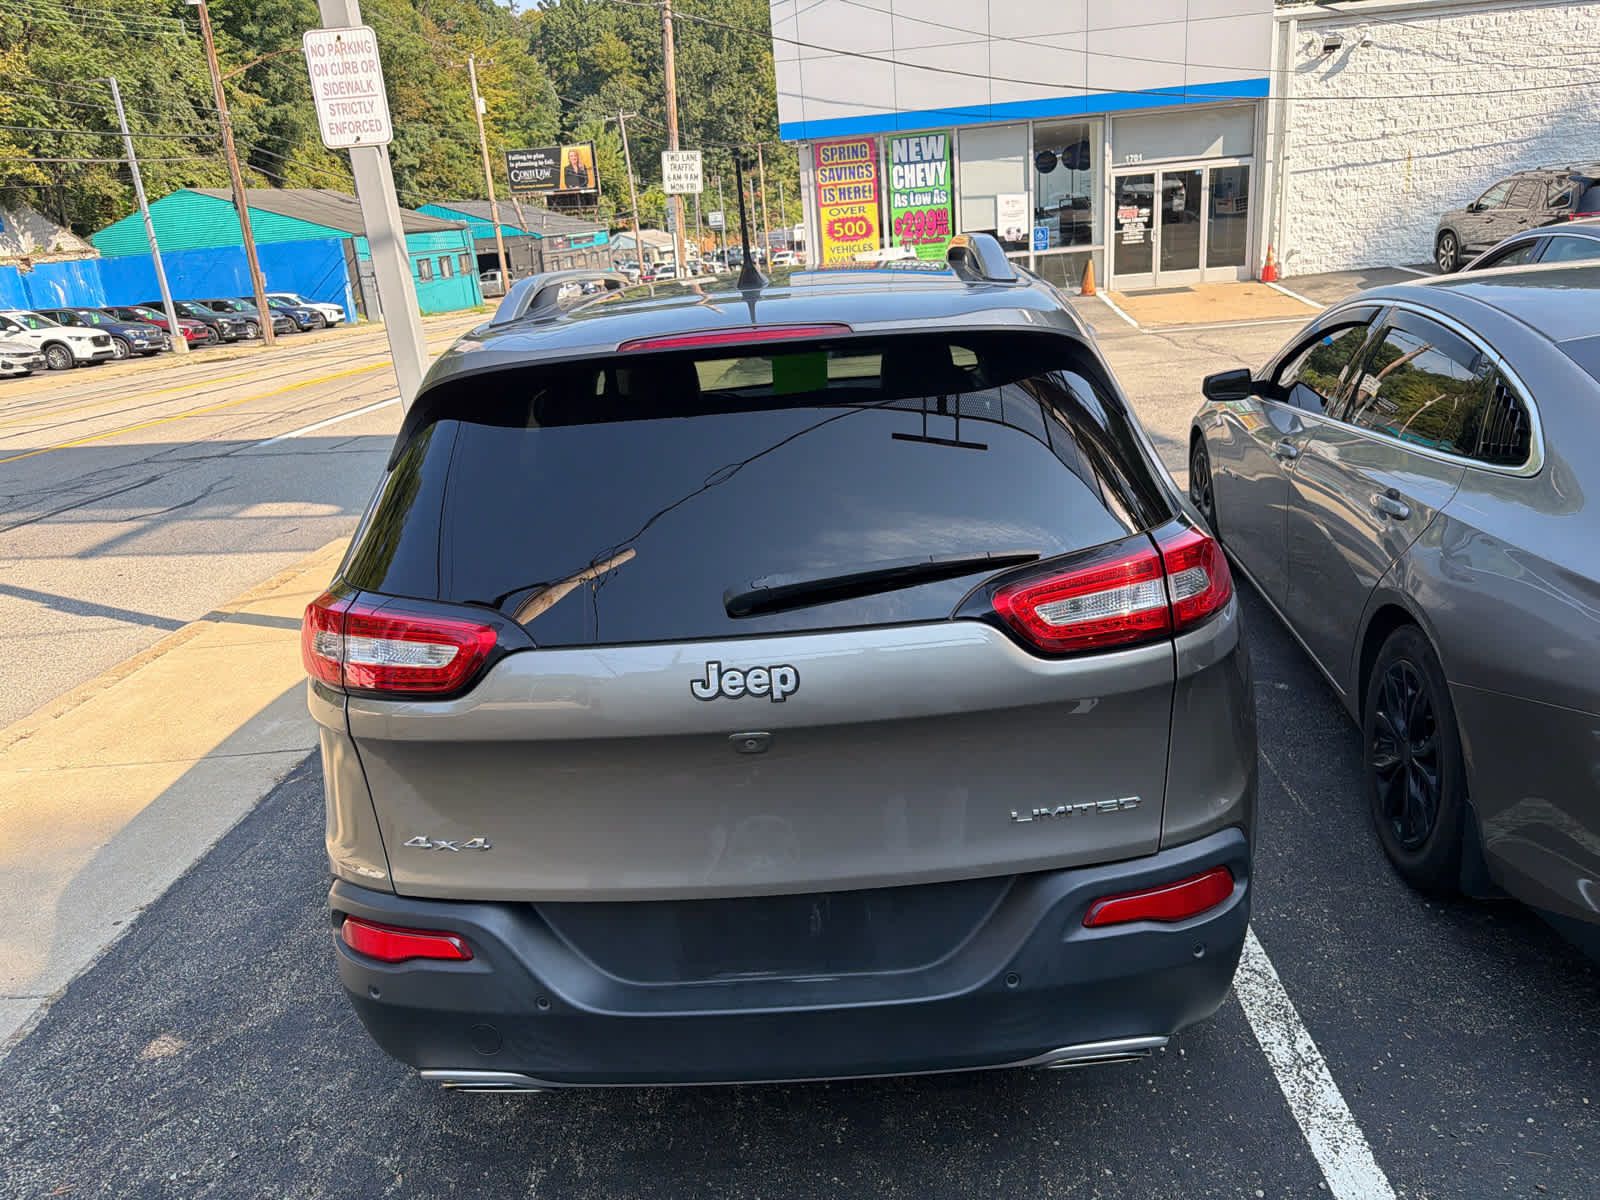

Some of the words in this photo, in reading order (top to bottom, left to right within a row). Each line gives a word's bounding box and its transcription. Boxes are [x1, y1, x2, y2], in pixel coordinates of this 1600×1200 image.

[310, 44, 325, 58] NO
[327, 40, 372, 57] PARKING
[313, 63, 329, 77] ON
[330, 61, 359, 76] CURB
[360, 60, 377, 73] OR
[322, 80, 375, 96] SIDEWALK
[328, 101, 375, 117] STRICTLY
[328, 120, 383, 135] ENFORCED
[821, 143, 868, 162] SPRING
[892, 134, 945, 162] NEW
[819, 163, 873, 183] SAVINGS
[892, 161, 947, 190] CHEVY
[823, 188, 836, 202] IS
[838, 185, 873, 200] HERE!
[828, 206, 867, 216] OVER
[833, 221, 867, 237] 500
[829, 243, 874, 255] VEHICLES
[690, 661, 800, 703] Jeep
[1010, 796, 1141, 822] LIMITED
